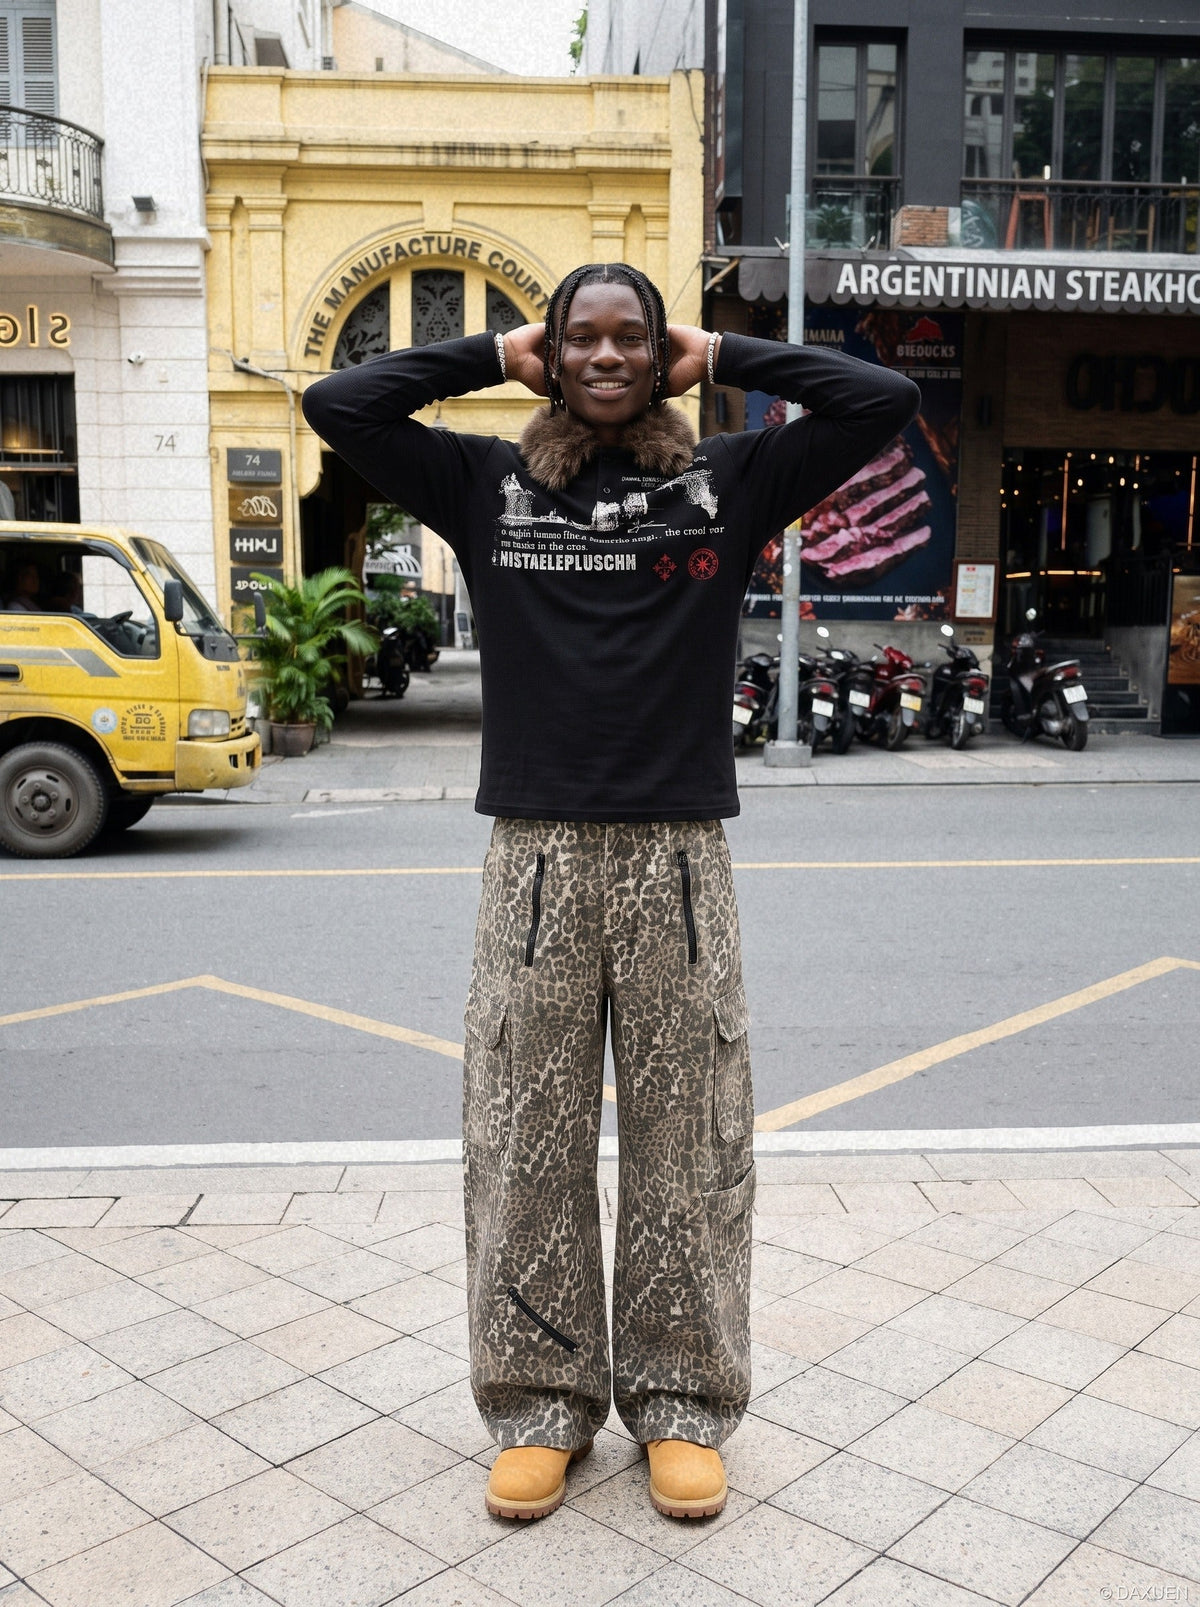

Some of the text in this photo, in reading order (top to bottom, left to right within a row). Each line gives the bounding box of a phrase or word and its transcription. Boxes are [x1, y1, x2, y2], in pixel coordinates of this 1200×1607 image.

[836, 263, 1055, 300] ARGENTINIAN
[304, 312, 331, 358] THE
[324, 235, 482, 310] MANUFACTURE
[154, 434, 177, 452] 74
[245, 454, 261, 467] 74
[664, 528, 681, 537] the
[537, 541, 546, 550] in
[549, 541, 564, 551] the
